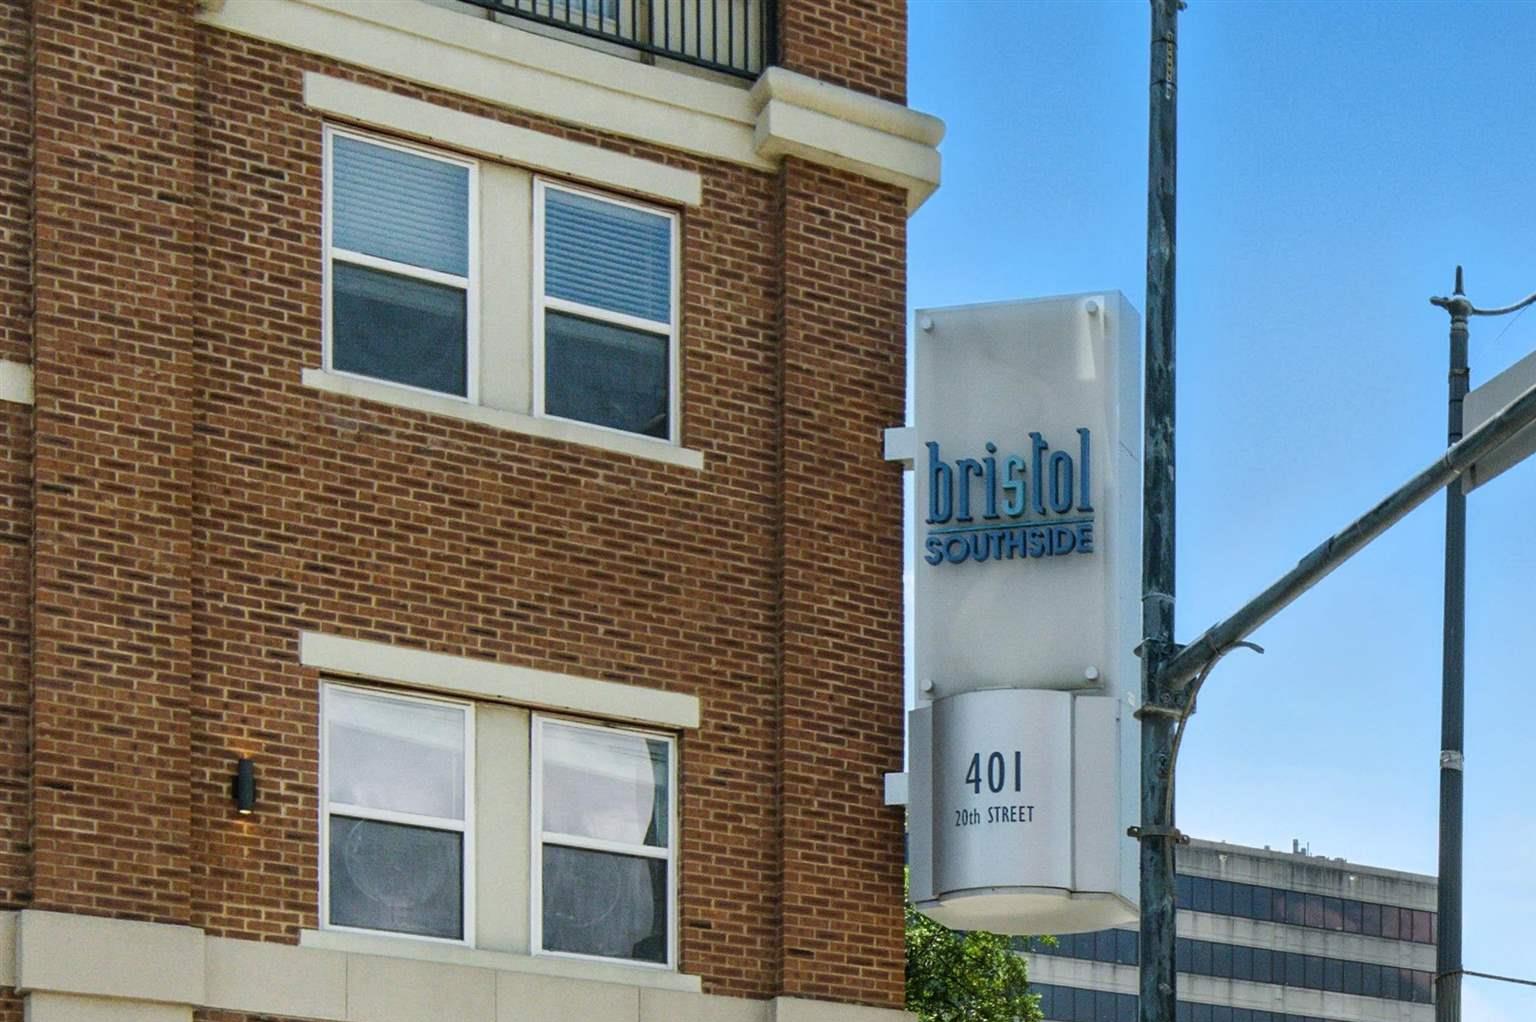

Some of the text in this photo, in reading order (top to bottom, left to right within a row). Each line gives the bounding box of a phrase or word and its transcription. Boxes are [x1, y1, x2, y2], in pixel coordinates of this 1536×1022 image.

[925, 427, 1094, 525] bristol
[924, 523, 1094, 567] SOUTHSIDE
[965, 751, 1021, 794] 401
[955, 805, 1035, 827] 20th STREET
